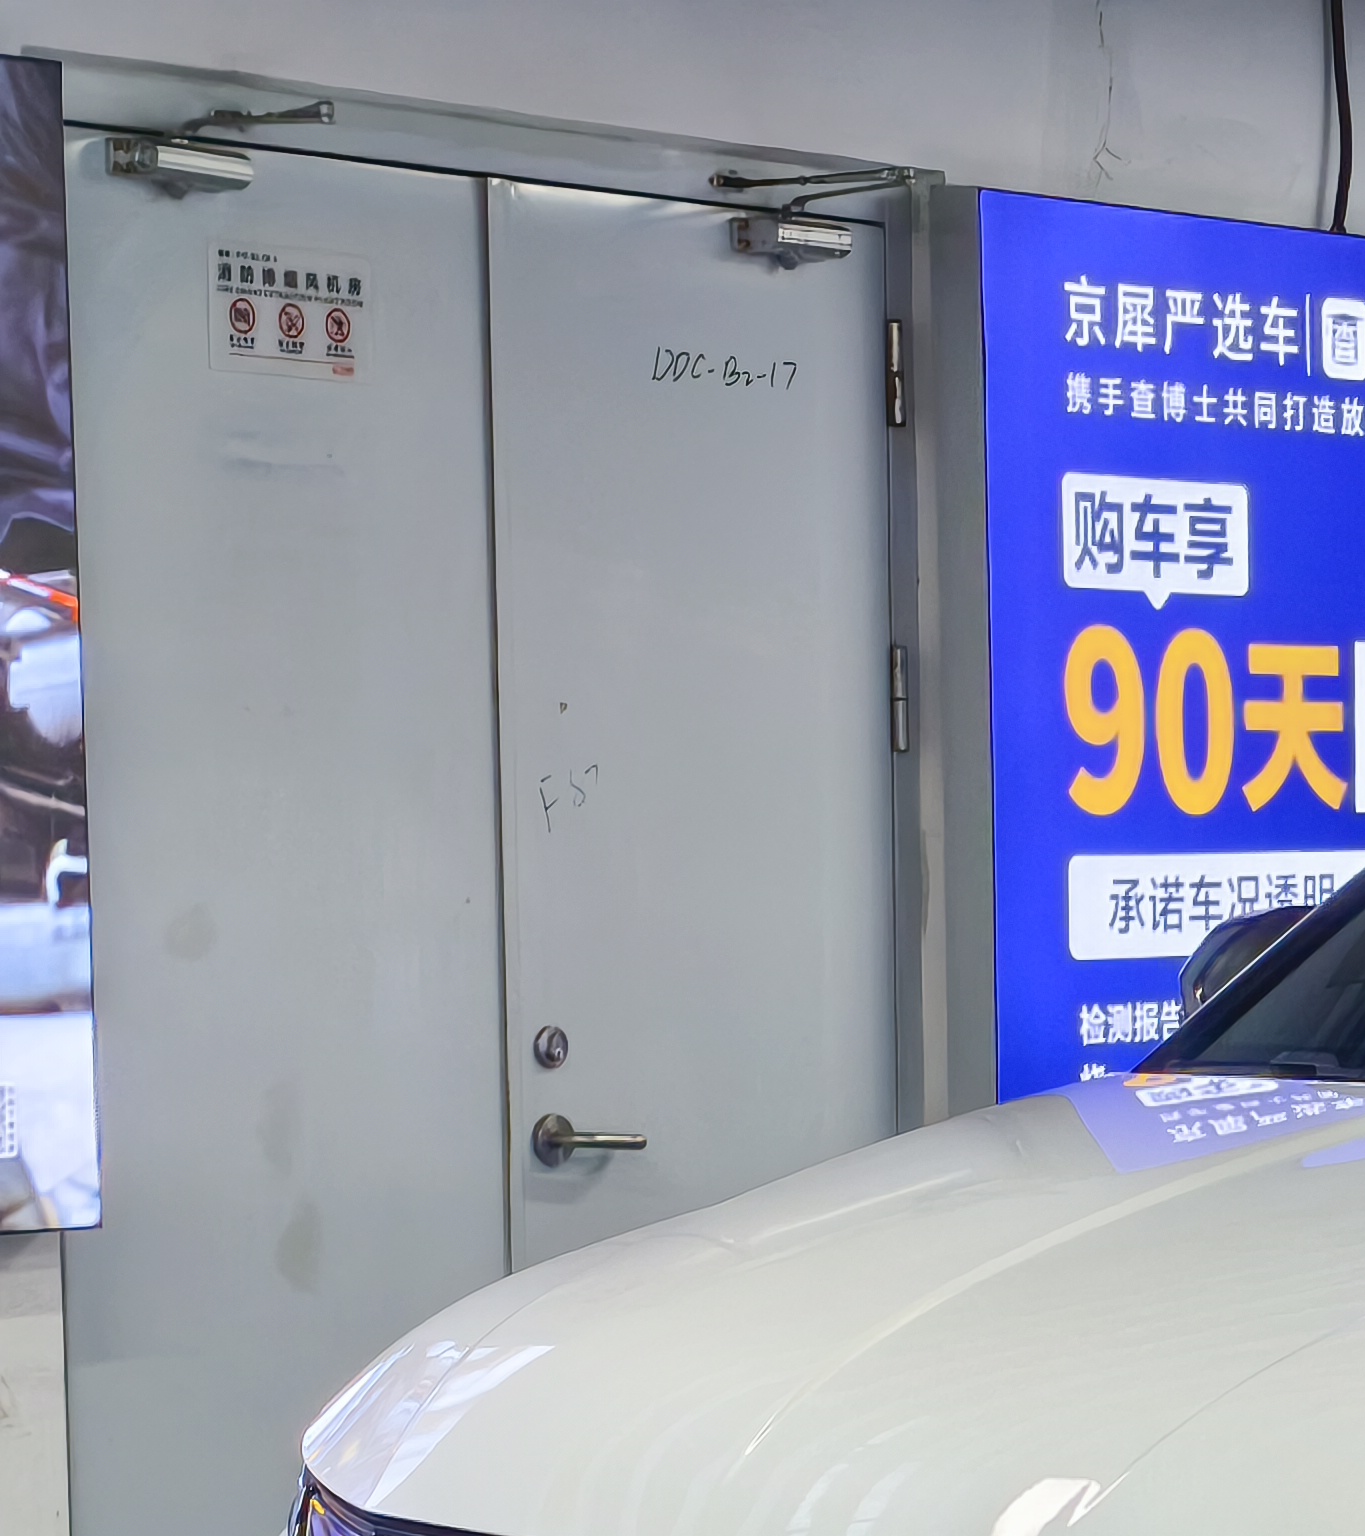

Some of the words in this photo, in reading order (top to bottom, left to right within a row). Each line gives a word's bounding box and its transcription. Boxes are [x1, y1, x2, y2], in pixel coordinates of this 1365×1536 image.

[1063, 274, 1299, 366] 京犀严选车
[1072, 490, 1235, 580] 购车享
[1079, 999, 1184, 1047] 检测报告
